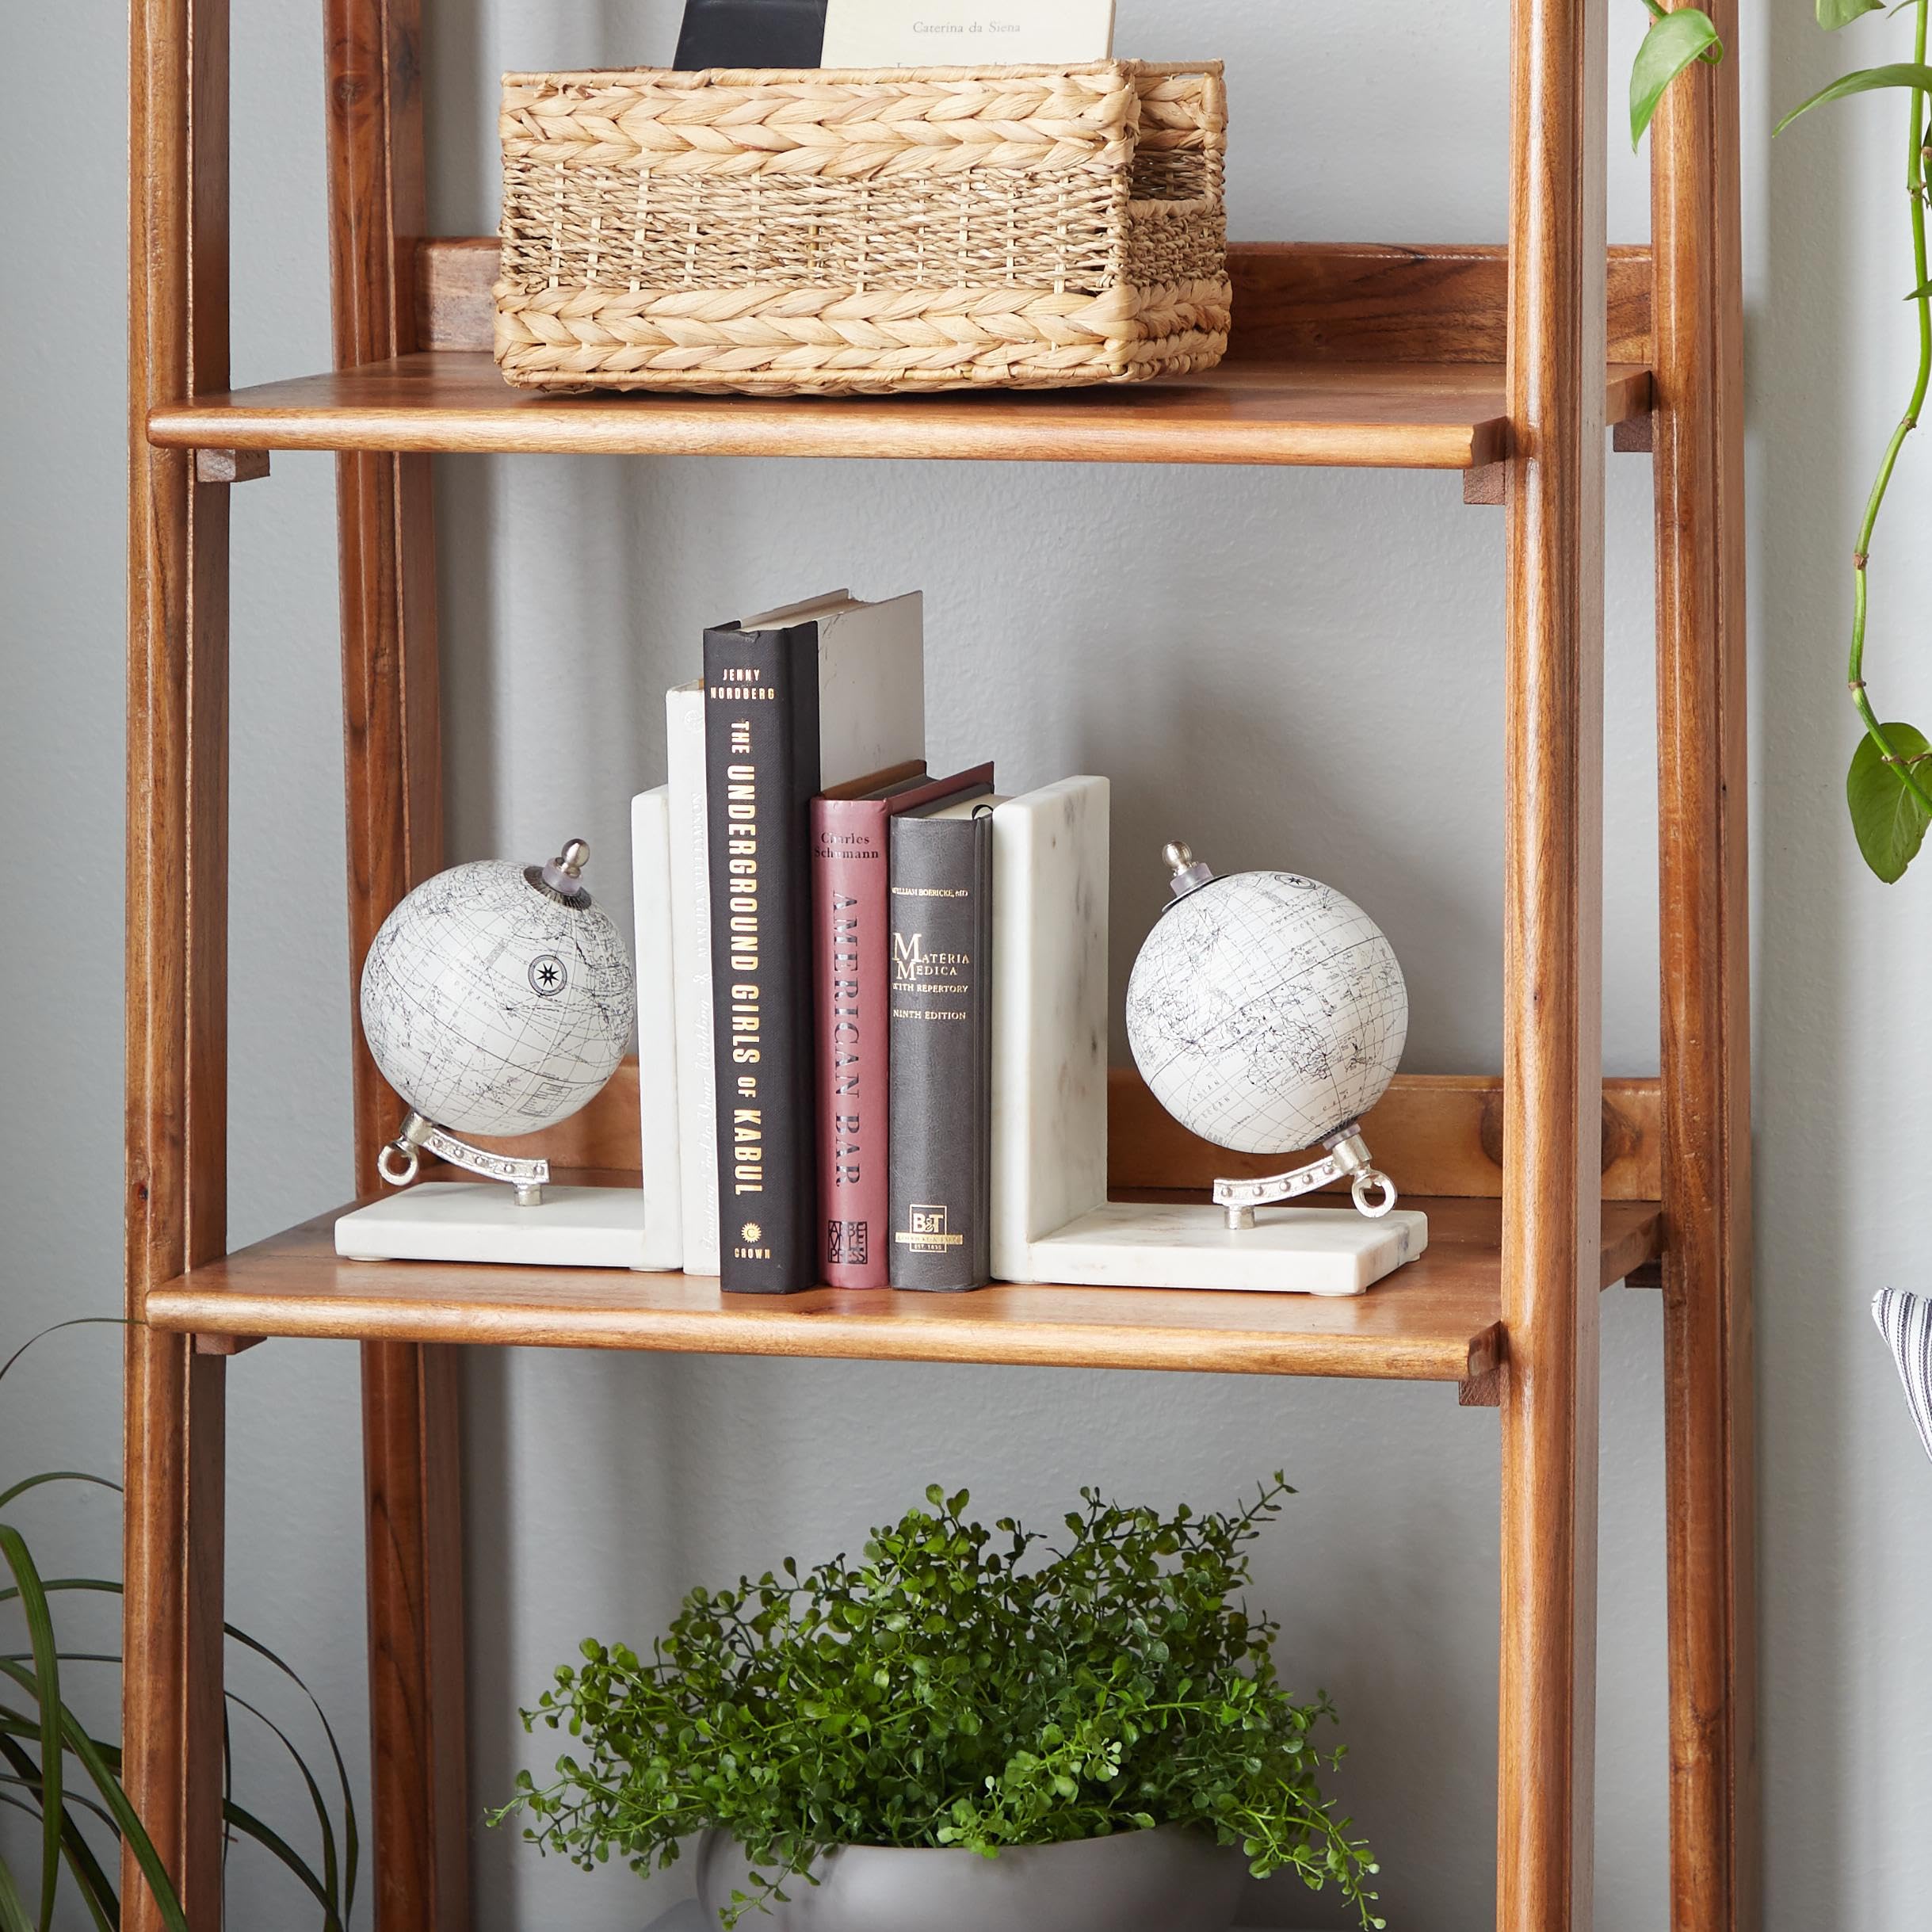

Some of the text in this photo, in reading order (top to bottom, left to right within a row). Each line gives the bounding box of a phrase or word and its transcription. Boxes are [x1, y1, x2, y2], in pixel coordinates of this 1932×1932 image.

[913, 21, 1021, 33] Caterina da Siena
[723, 669, 760, 682] JENNY
[711, 686, 774, 700] NORDBERG
[892, 932, 970, 964] MATERIA
[727, 720, 763, 1196] THE UNDERGROUND GIRLS OF KABUL
[896, 960, 958, 981] MEDICA
[916, 983, 968, 993] REPERTORY
[893, 1009, 966, 1020] NINTH EDITION
[833, 891, 861, 1188] AMERICAN BAR
[912, 1213, 944, 1233] B&T
[735, 1247, 770, 1259] CROWN
